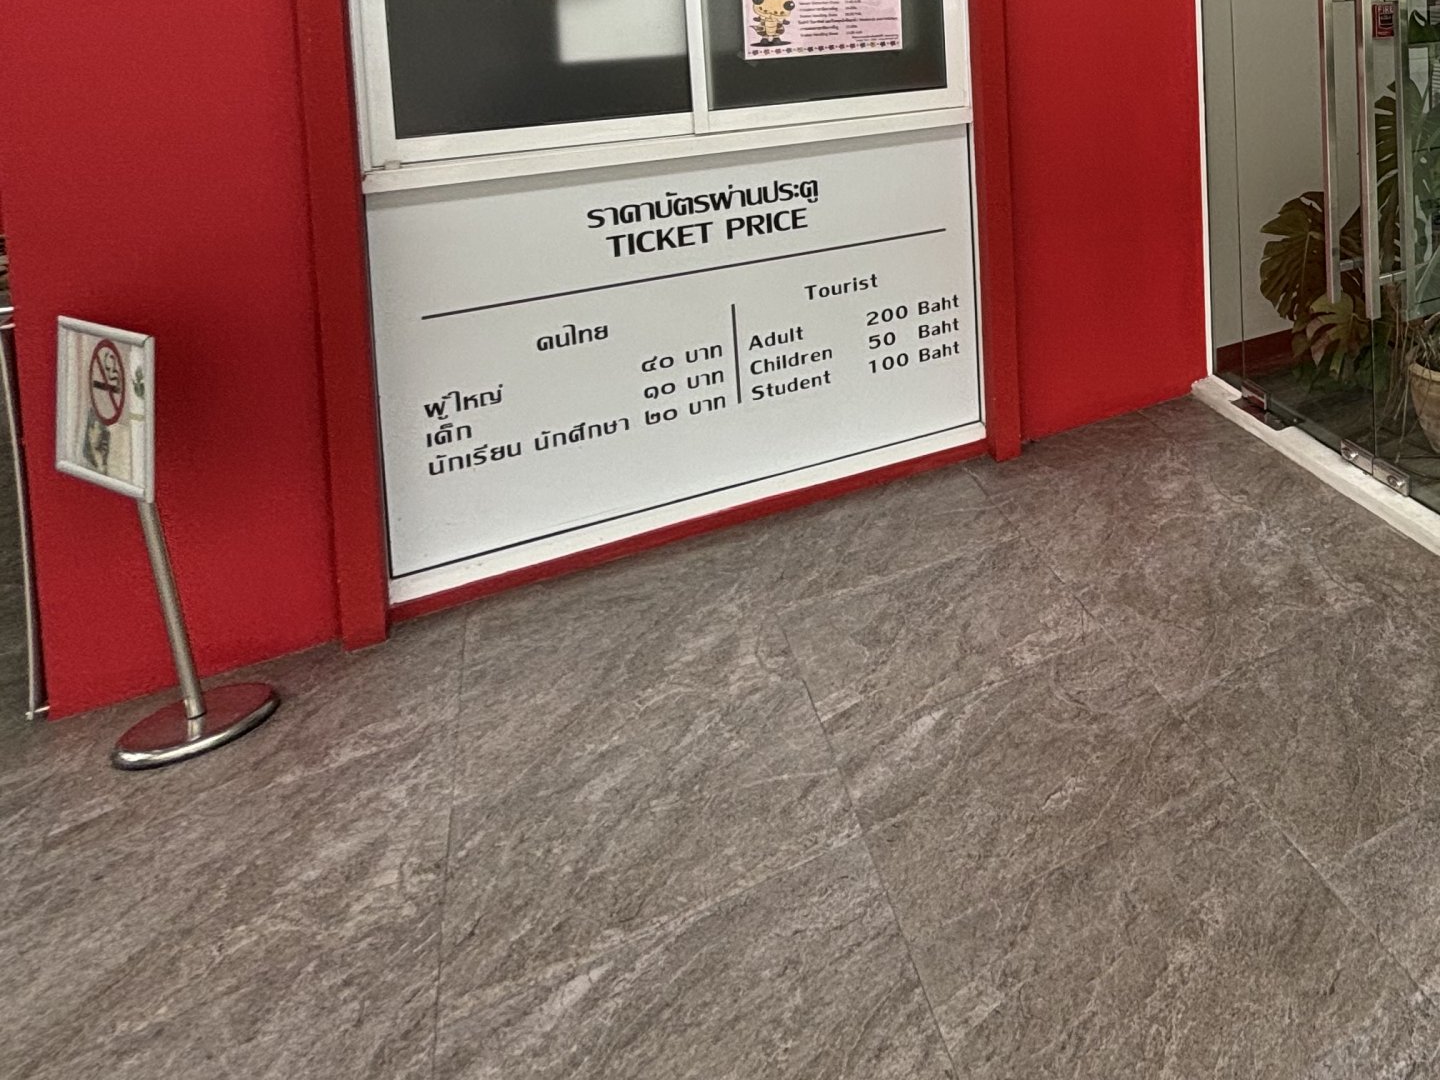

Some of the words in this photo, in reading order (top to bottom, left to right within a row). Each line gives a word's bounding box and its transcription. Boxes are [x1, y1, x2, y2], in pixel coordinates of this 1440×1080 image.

[587, 180, 819, 229] ราคาบัตรผ่านประตู
[606, 221, 713, 258] TICKET
[726, 207, 808, 240] PRICE
[804, 273, 878, 301] Tourist
[536, 324, 609, 352] คนไทย
[748, 326, 804, 351] Adult
[866, 305, 908, 326] 200
[917, 294, 960, 315] Baht
[750, 348, 833, 375] Children
[868, 331, 896, 349] 50
[917, 318, 960, 339] Baht
[424, 384, 503, 420] ผู้ใหญ่
[685, 344, 724, 364] บาท
[751, 370, 832, 401] Student
[868, 353, 909, 374] 100
[918, 341, 960, 363] Baht
[426, 422, 473, 448] เด็ก
[687, 369, 724, 390] บาท
[428, 442, 522, 476] นักเรียน
[534, 417, 630, 452] นักศึกษา
[689, 394, 726, 416] บาท
